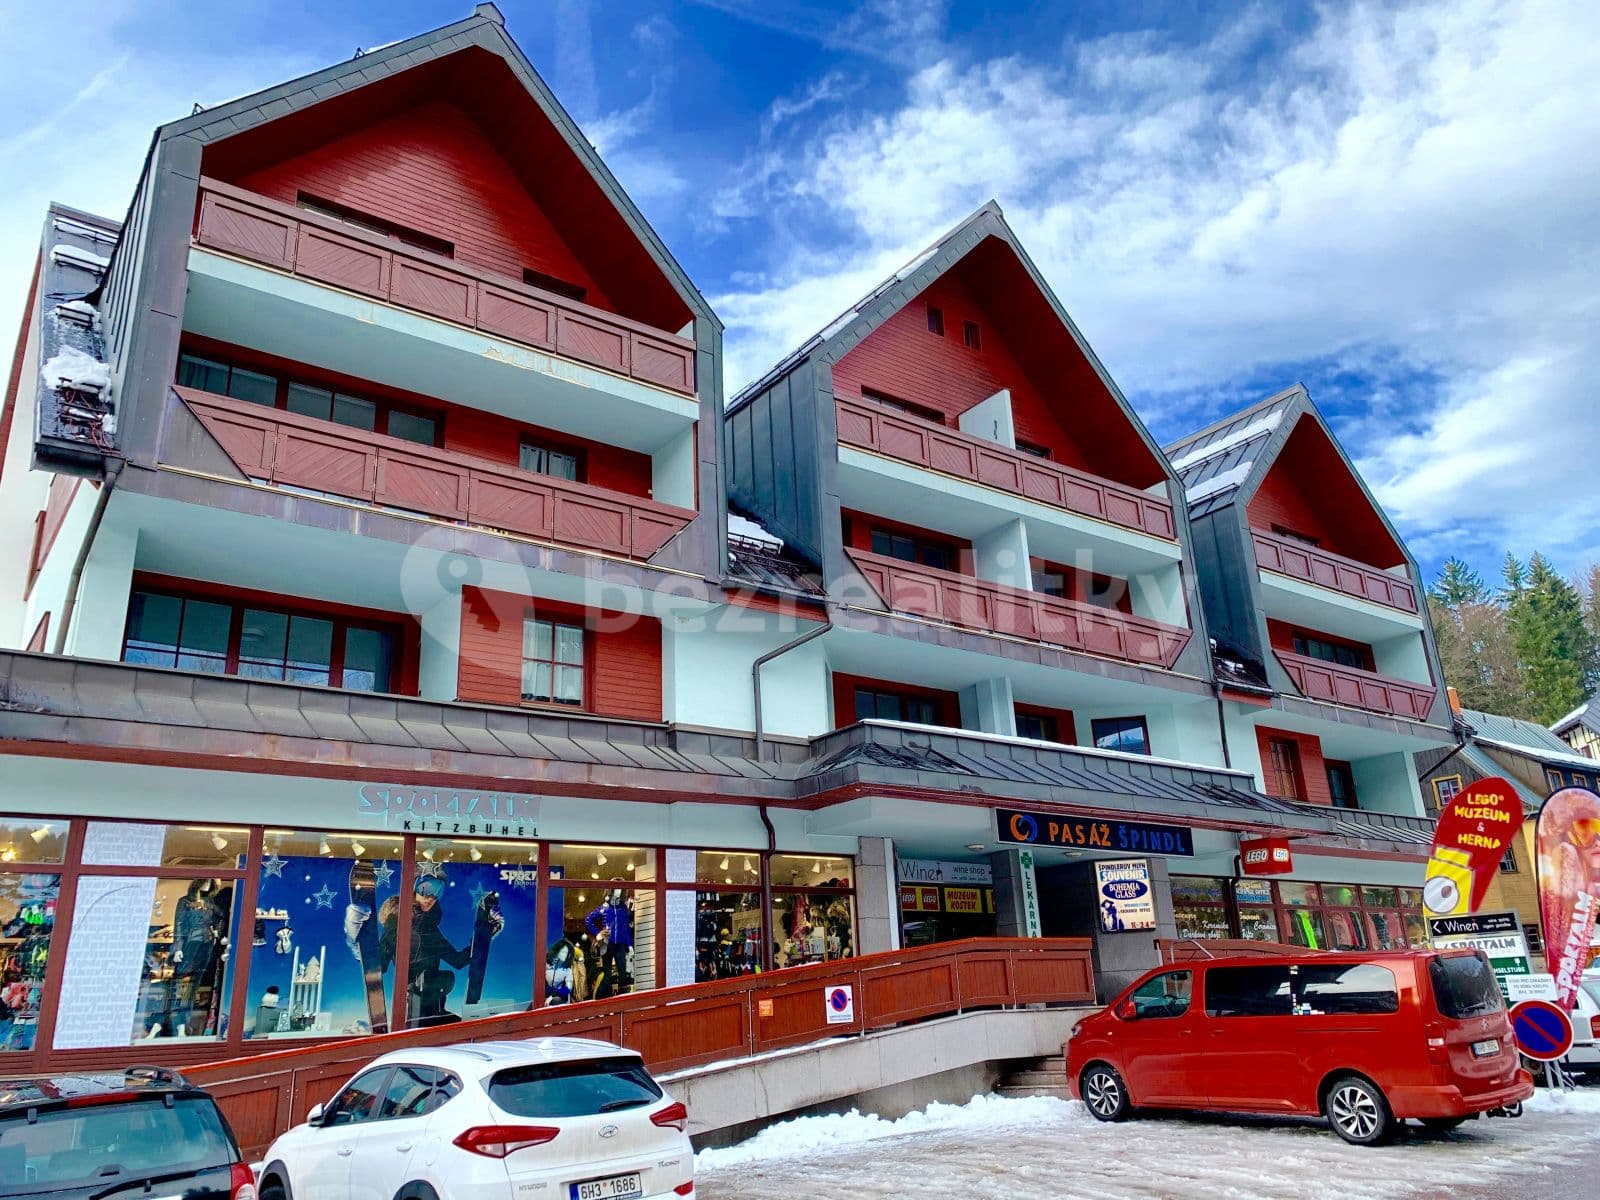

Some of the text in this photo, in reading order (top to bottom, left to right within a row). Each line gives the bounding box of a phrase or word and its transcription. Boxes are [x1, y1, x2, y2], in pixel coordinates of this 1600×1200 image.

[1454, 805, 1511, 824] MUZEUM
[1477, 822, 1485, 832] &
[1049, 822, 1185, 852] PASÁŽ ŠPINDL
[1457, 833, 1501, 849] HERNA
[1246, 850, 1267, 863] LEGO
[1102, 869, 1145, 881] SOUVENIR
[1109, 882, 1140, 891] BOHEMIA
[903, 893, 916, 903] LEGO
[923, 894, 936, 904] LEGO
[947, 890, 978, 901] MUZEUM
[1115, 890, 1136, 898] GLASS
[950, 900, 976, 911] KOSTEK
[581, 1183, 601, 1199] 6H3
[610, 1177, 636, 1194] 1686
